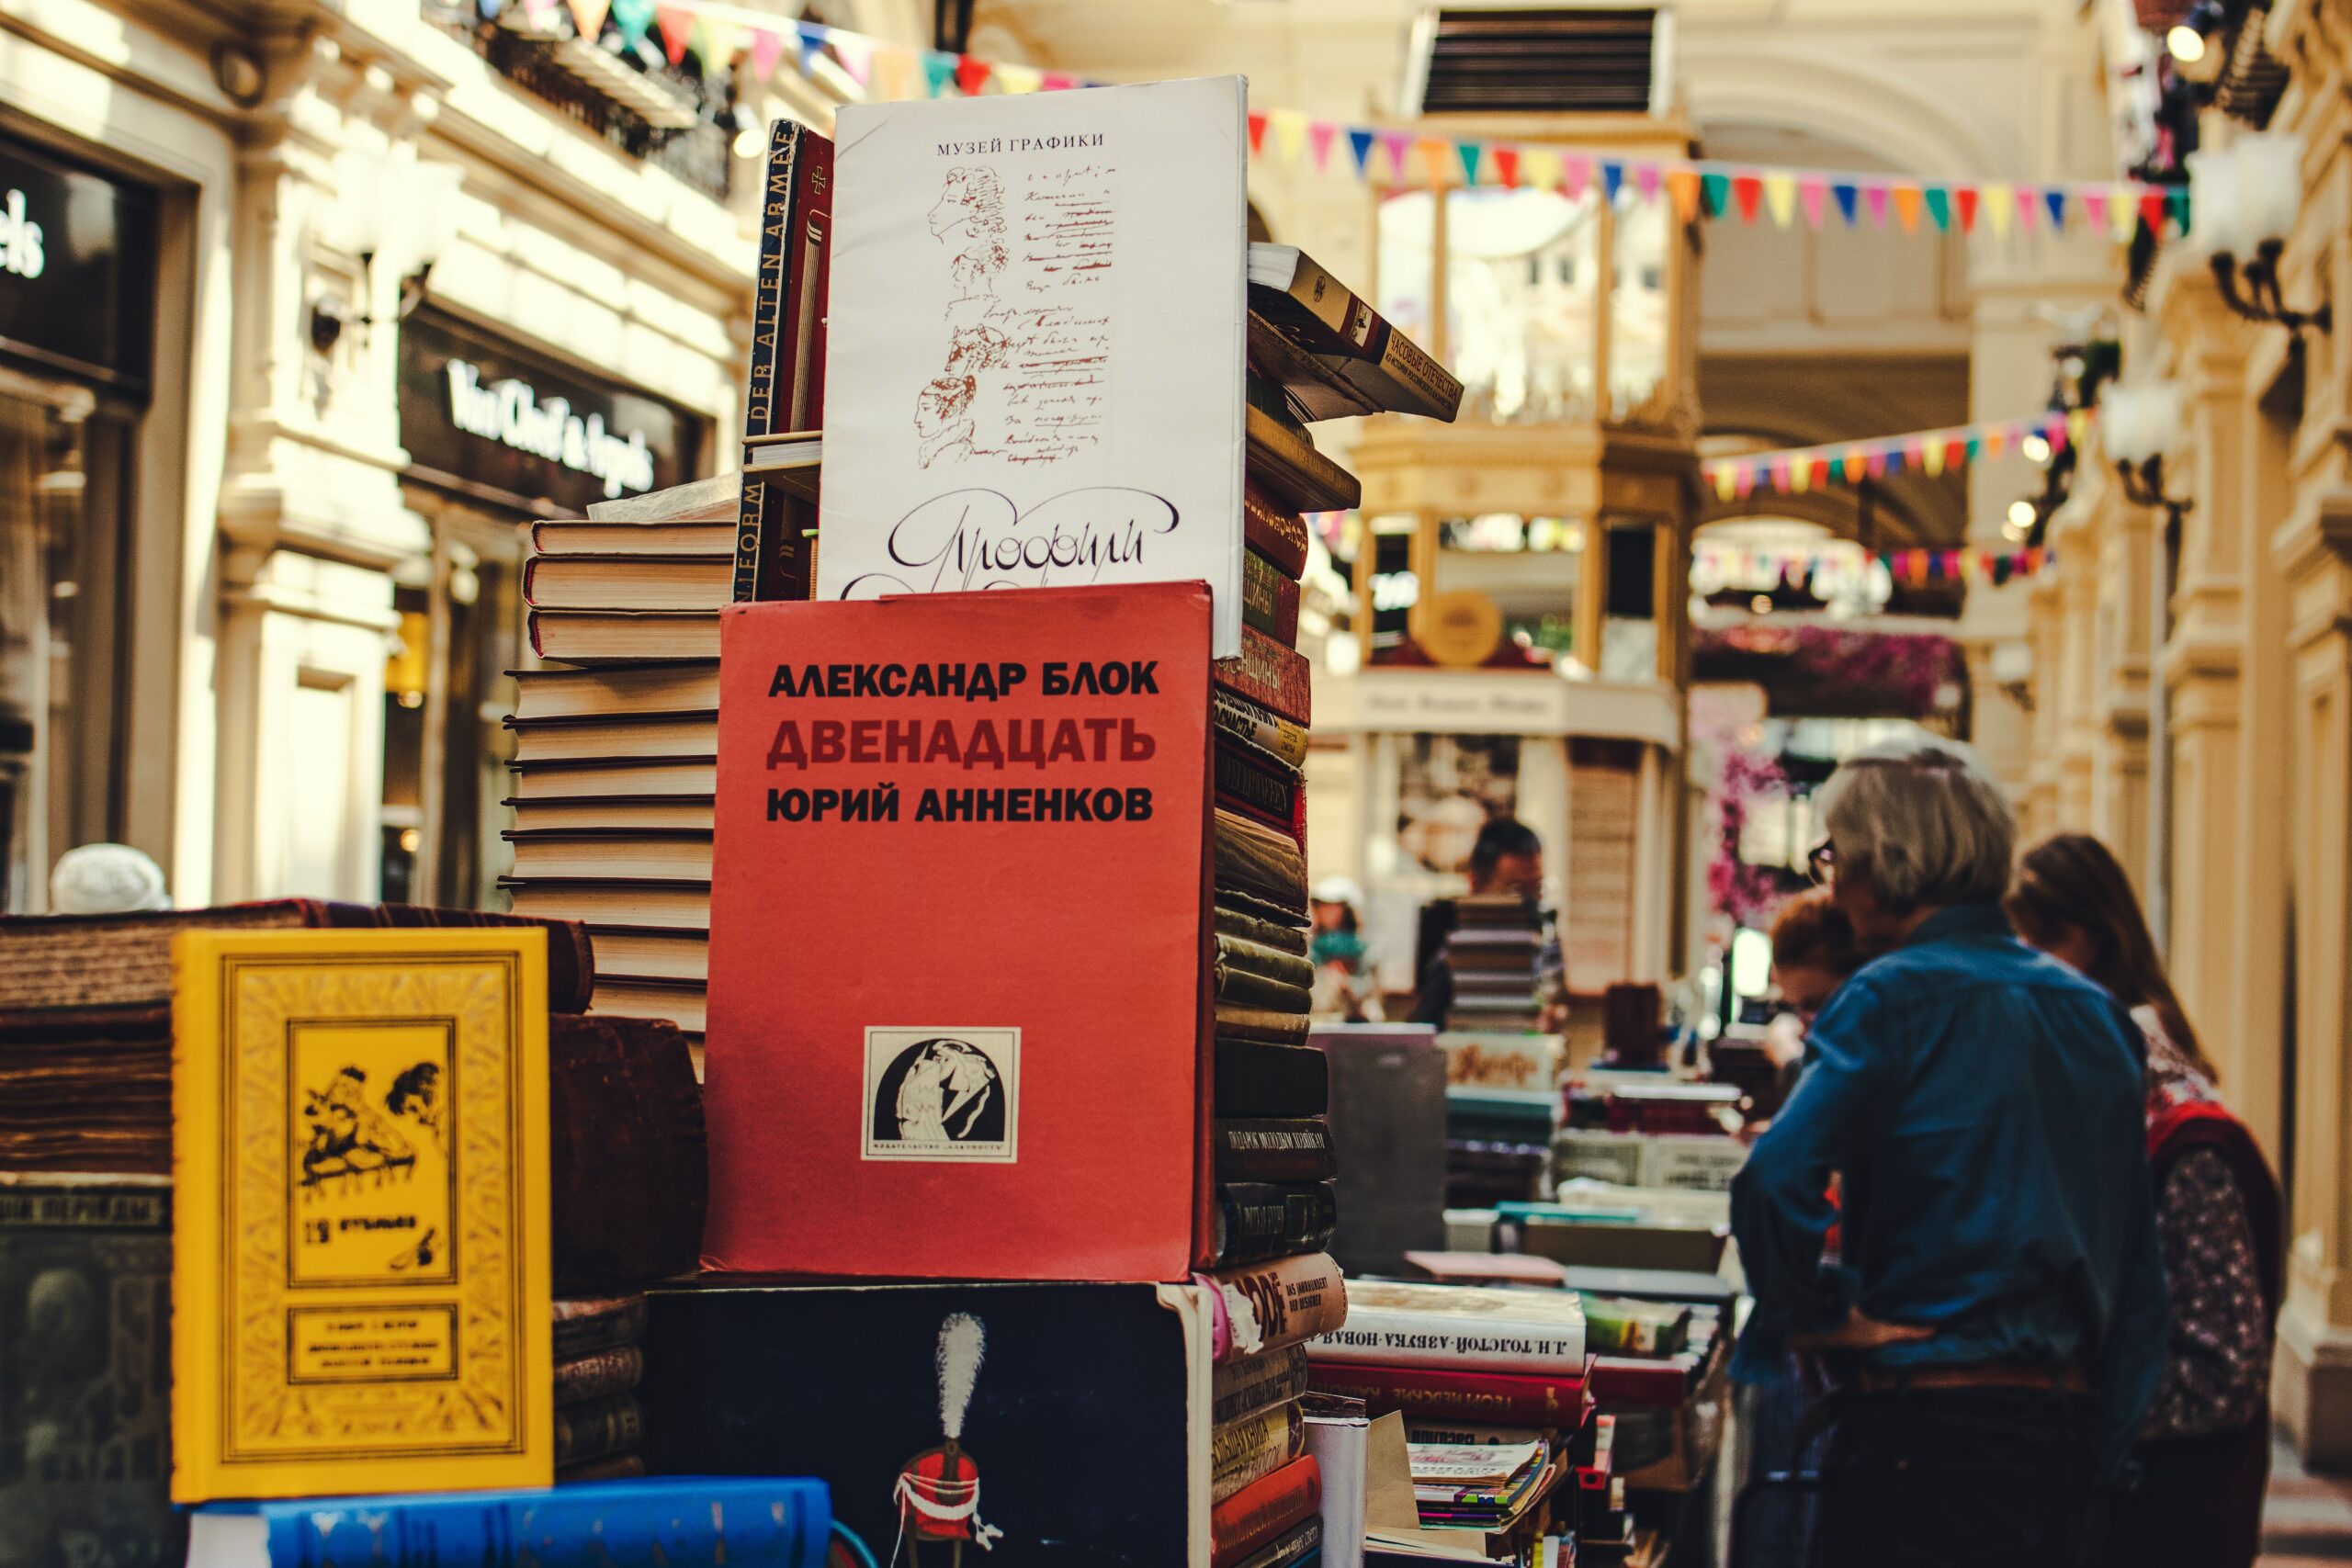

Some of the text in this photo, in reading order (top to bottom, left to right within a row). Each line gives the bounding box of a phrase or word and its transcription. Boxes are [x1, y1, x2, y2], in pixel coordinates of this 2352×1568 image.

[937, 133, 1103, 156] МУЗЕЙ ГРАФИКИ
[764, 130, 794, 240] ARMEE
[756, 254, 782, 351] ALTEN
[1391, 333, 1459, 402] ЧАСОВЫЕ ОТЕЧЕСТВА
[750, 366, 773, 421] DER
[768, 660, 1160, 702] АЛЕКСАНДР БЛОК
[766, 717, 1157, 770] ДВЕНАДЦАТЬ
[766, 782, 1154, 822] ЮРИЙ АННЕНКОВ
[1228, 1131, 1260, 1151] ПОДАРОК
[1286, 1282, 1296, 1297] DAS
[1296, 1276, 1329, 1296] JAHRHUNDERT
[1289, 1293, 1322, 1313] DER DESIGNER
[1323, 1331, 1378, 1346] НОВАЯ
[1385, 1333, 1450, 1349] АЗБУКА
[1456, 1337, 1532, 1354] ТОЛСТОЙ
